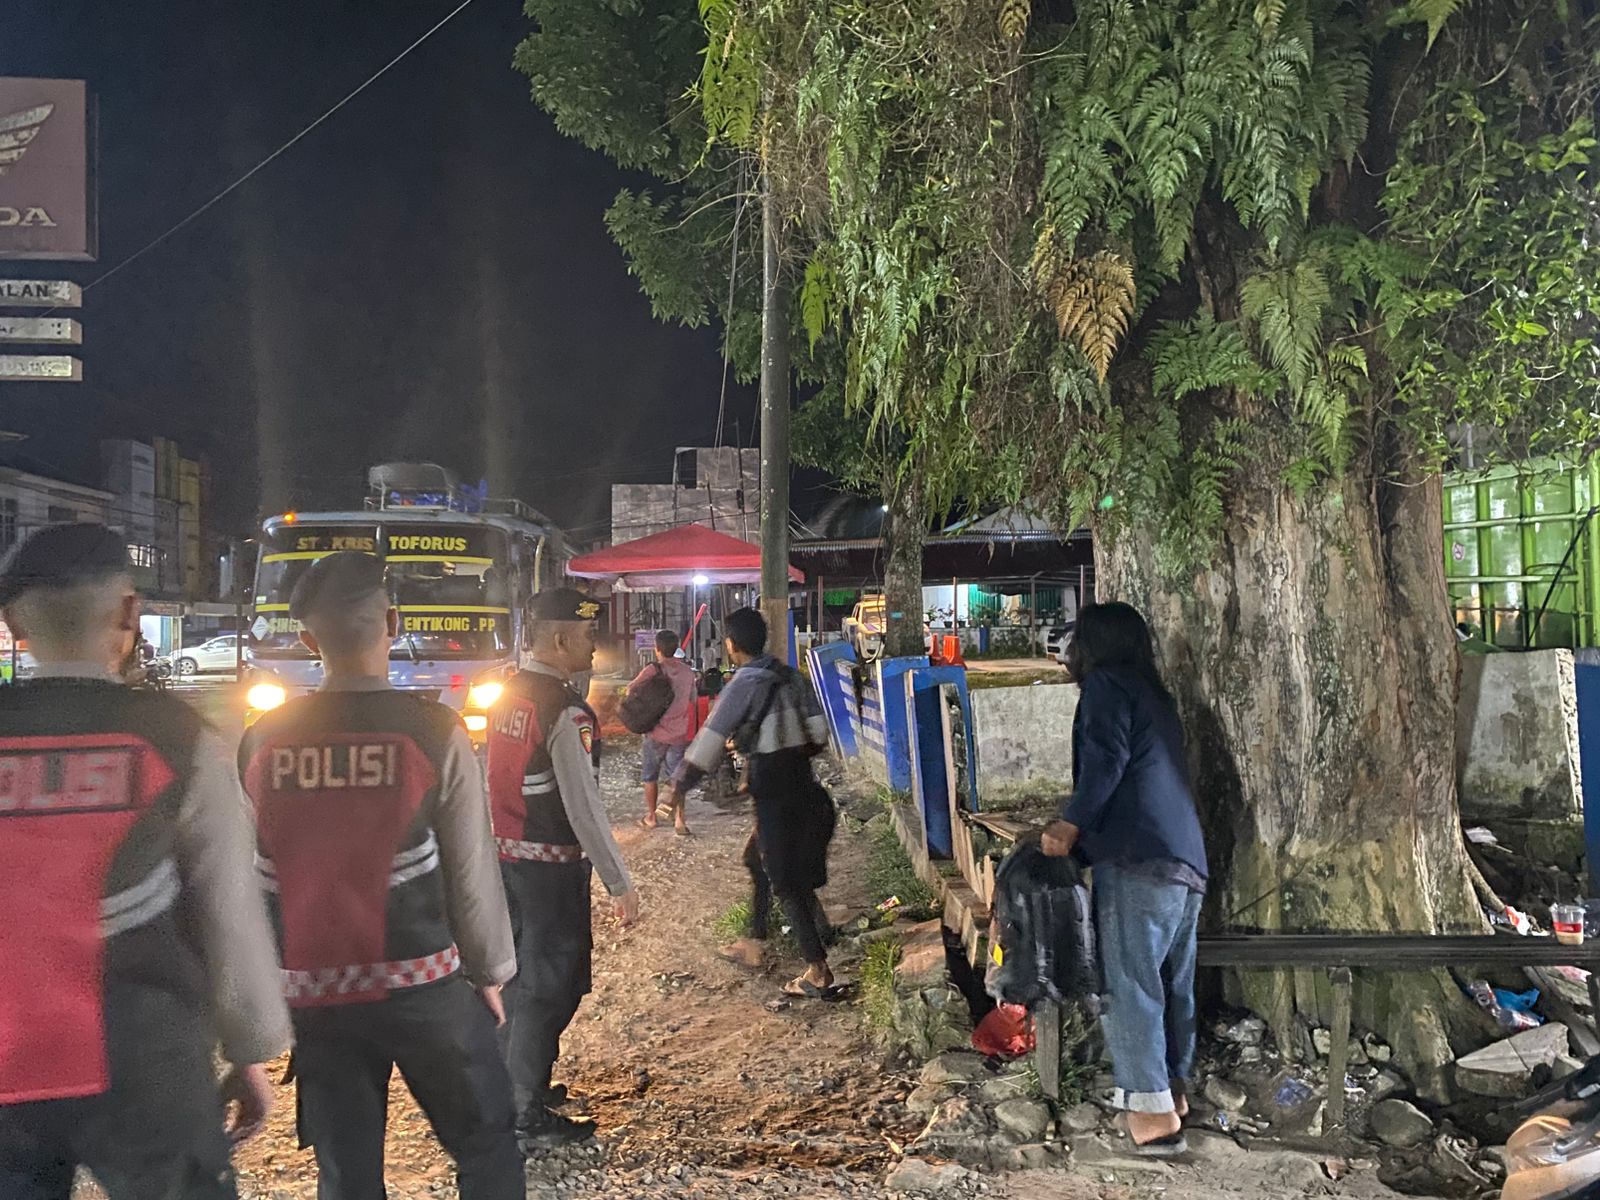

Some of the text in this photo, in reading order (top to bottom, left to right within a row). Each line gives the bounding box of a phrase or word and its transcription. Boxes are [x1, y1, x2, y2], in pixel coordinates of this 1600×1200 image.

[389, 536, 467, 551] TOFORUS
[404, 616, 470, 631] ENTIKONG
[271, 743, 397, 790] POLISI
